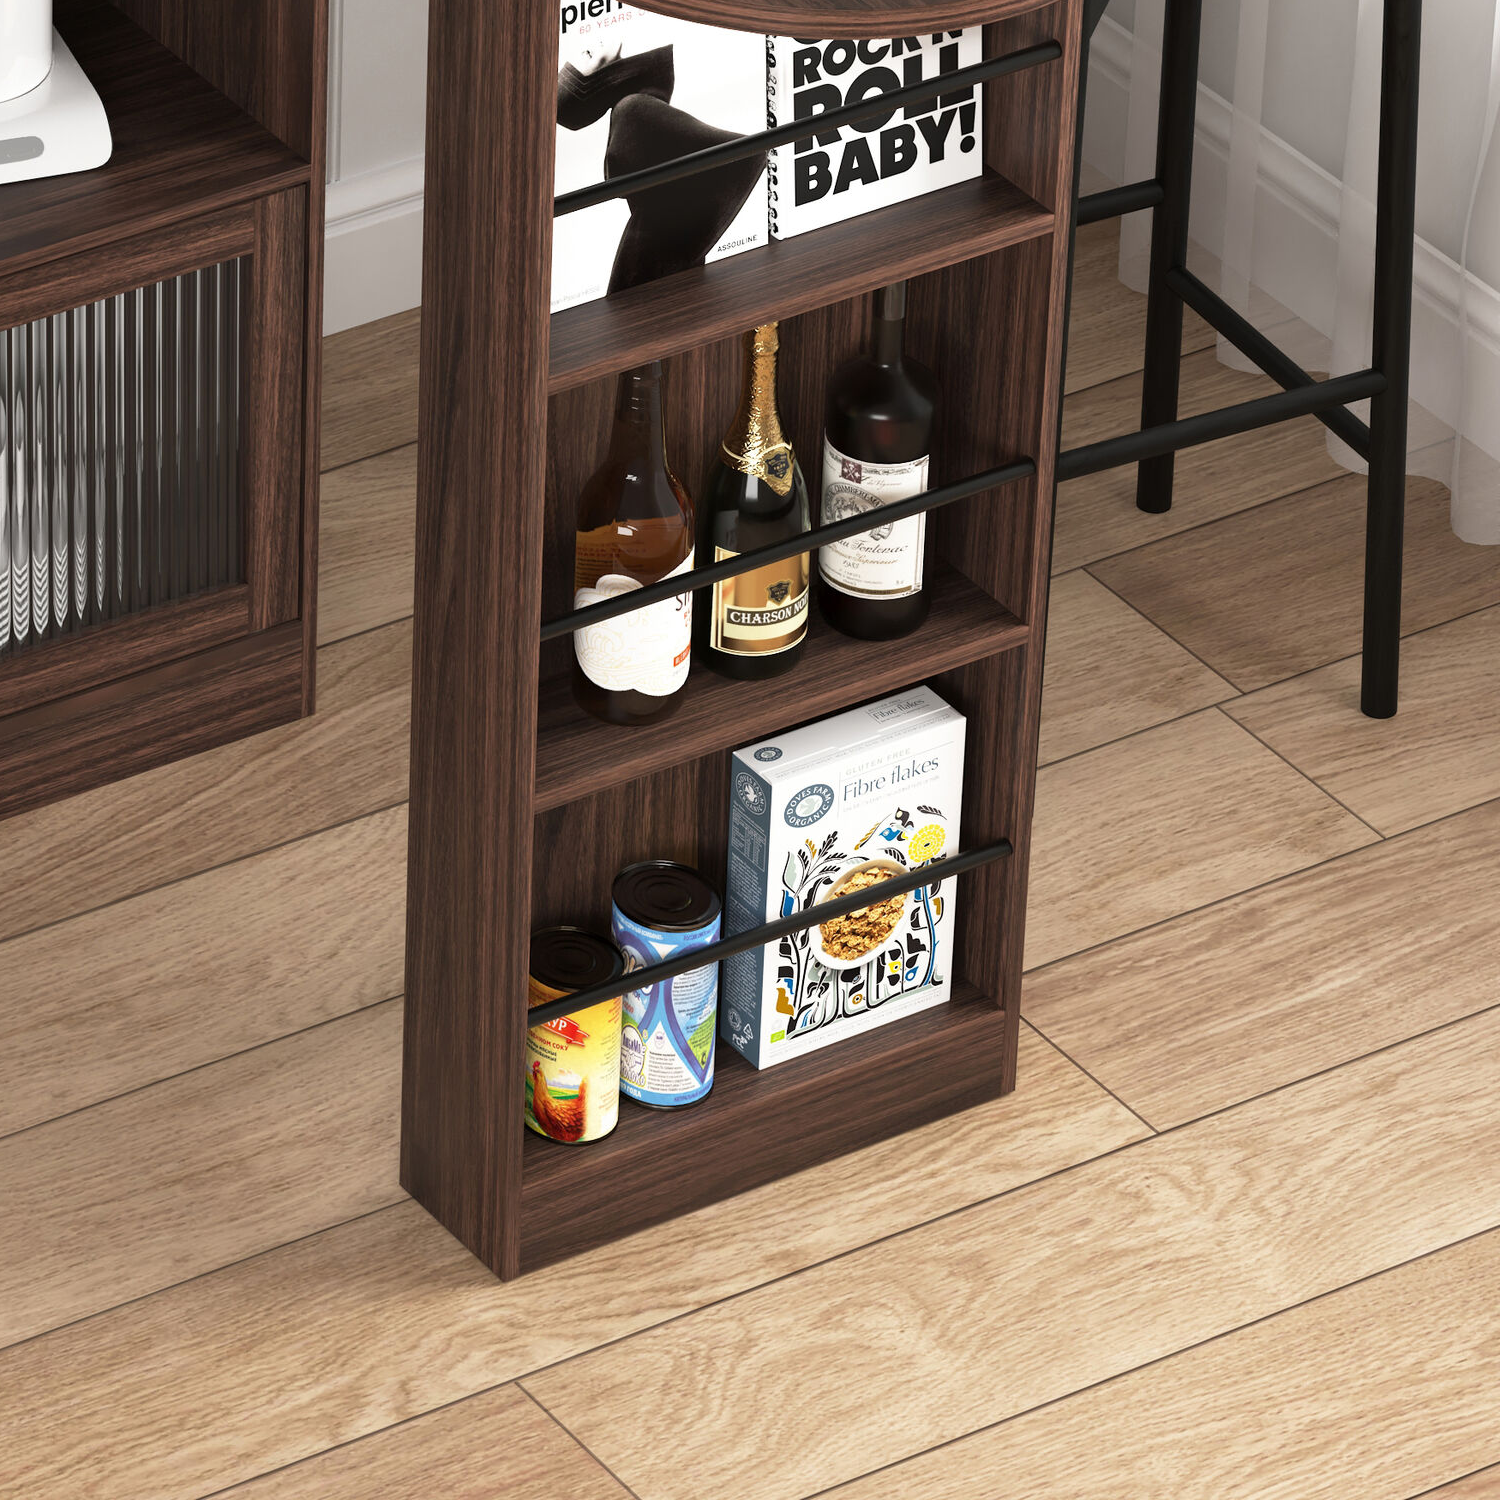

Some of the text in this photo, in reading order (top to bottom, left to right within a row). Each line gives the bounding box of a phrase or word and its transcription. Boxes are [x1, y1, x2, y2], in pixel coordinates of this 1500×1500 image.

[579, 24, 592, 34] 60
[597, 12, 632, 28] YEARS
[794, 42, 974, 155] ROLL
[794, 102, 976, 207] BABY!
[718, 234, 758, 252] ASSOULINE
[730, 606, 792, 624] CHARSON
[873, 700, 925, 720] Fibre flakes
[844, 778, 886, 801] Fibre
[891, 757, 939, 784] flakes
[787, 786, 832, 815] DOVES FARM
[789, 804, 829, 826] ORGANIC
